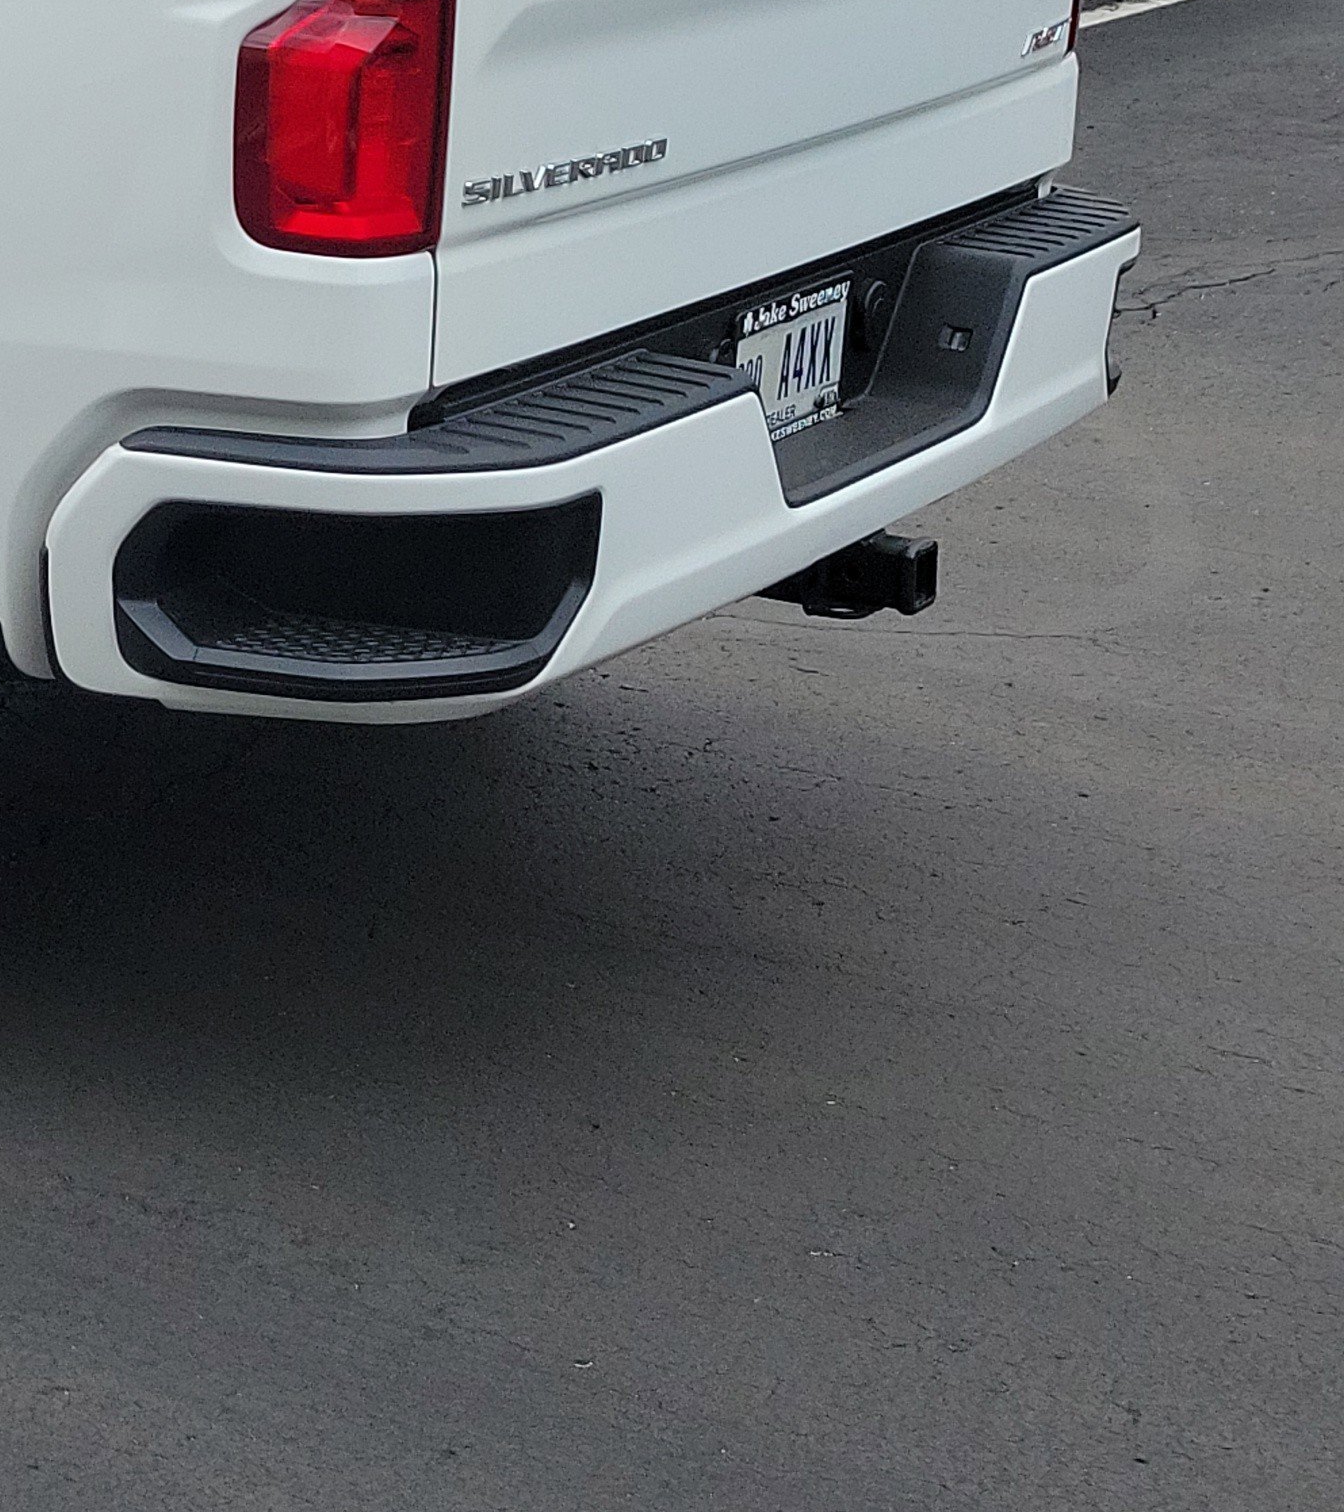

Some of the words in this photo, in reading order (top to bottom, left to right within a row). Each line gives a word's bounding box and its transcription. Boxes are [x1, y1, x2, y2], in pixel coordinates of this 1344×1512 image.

[462, 138, 668, 206] SILVERADO
[754, 303, 787, 331] Jake
[789, 281, 851, 316] Sweeney
[777, 316, 836, 401] A4XX
